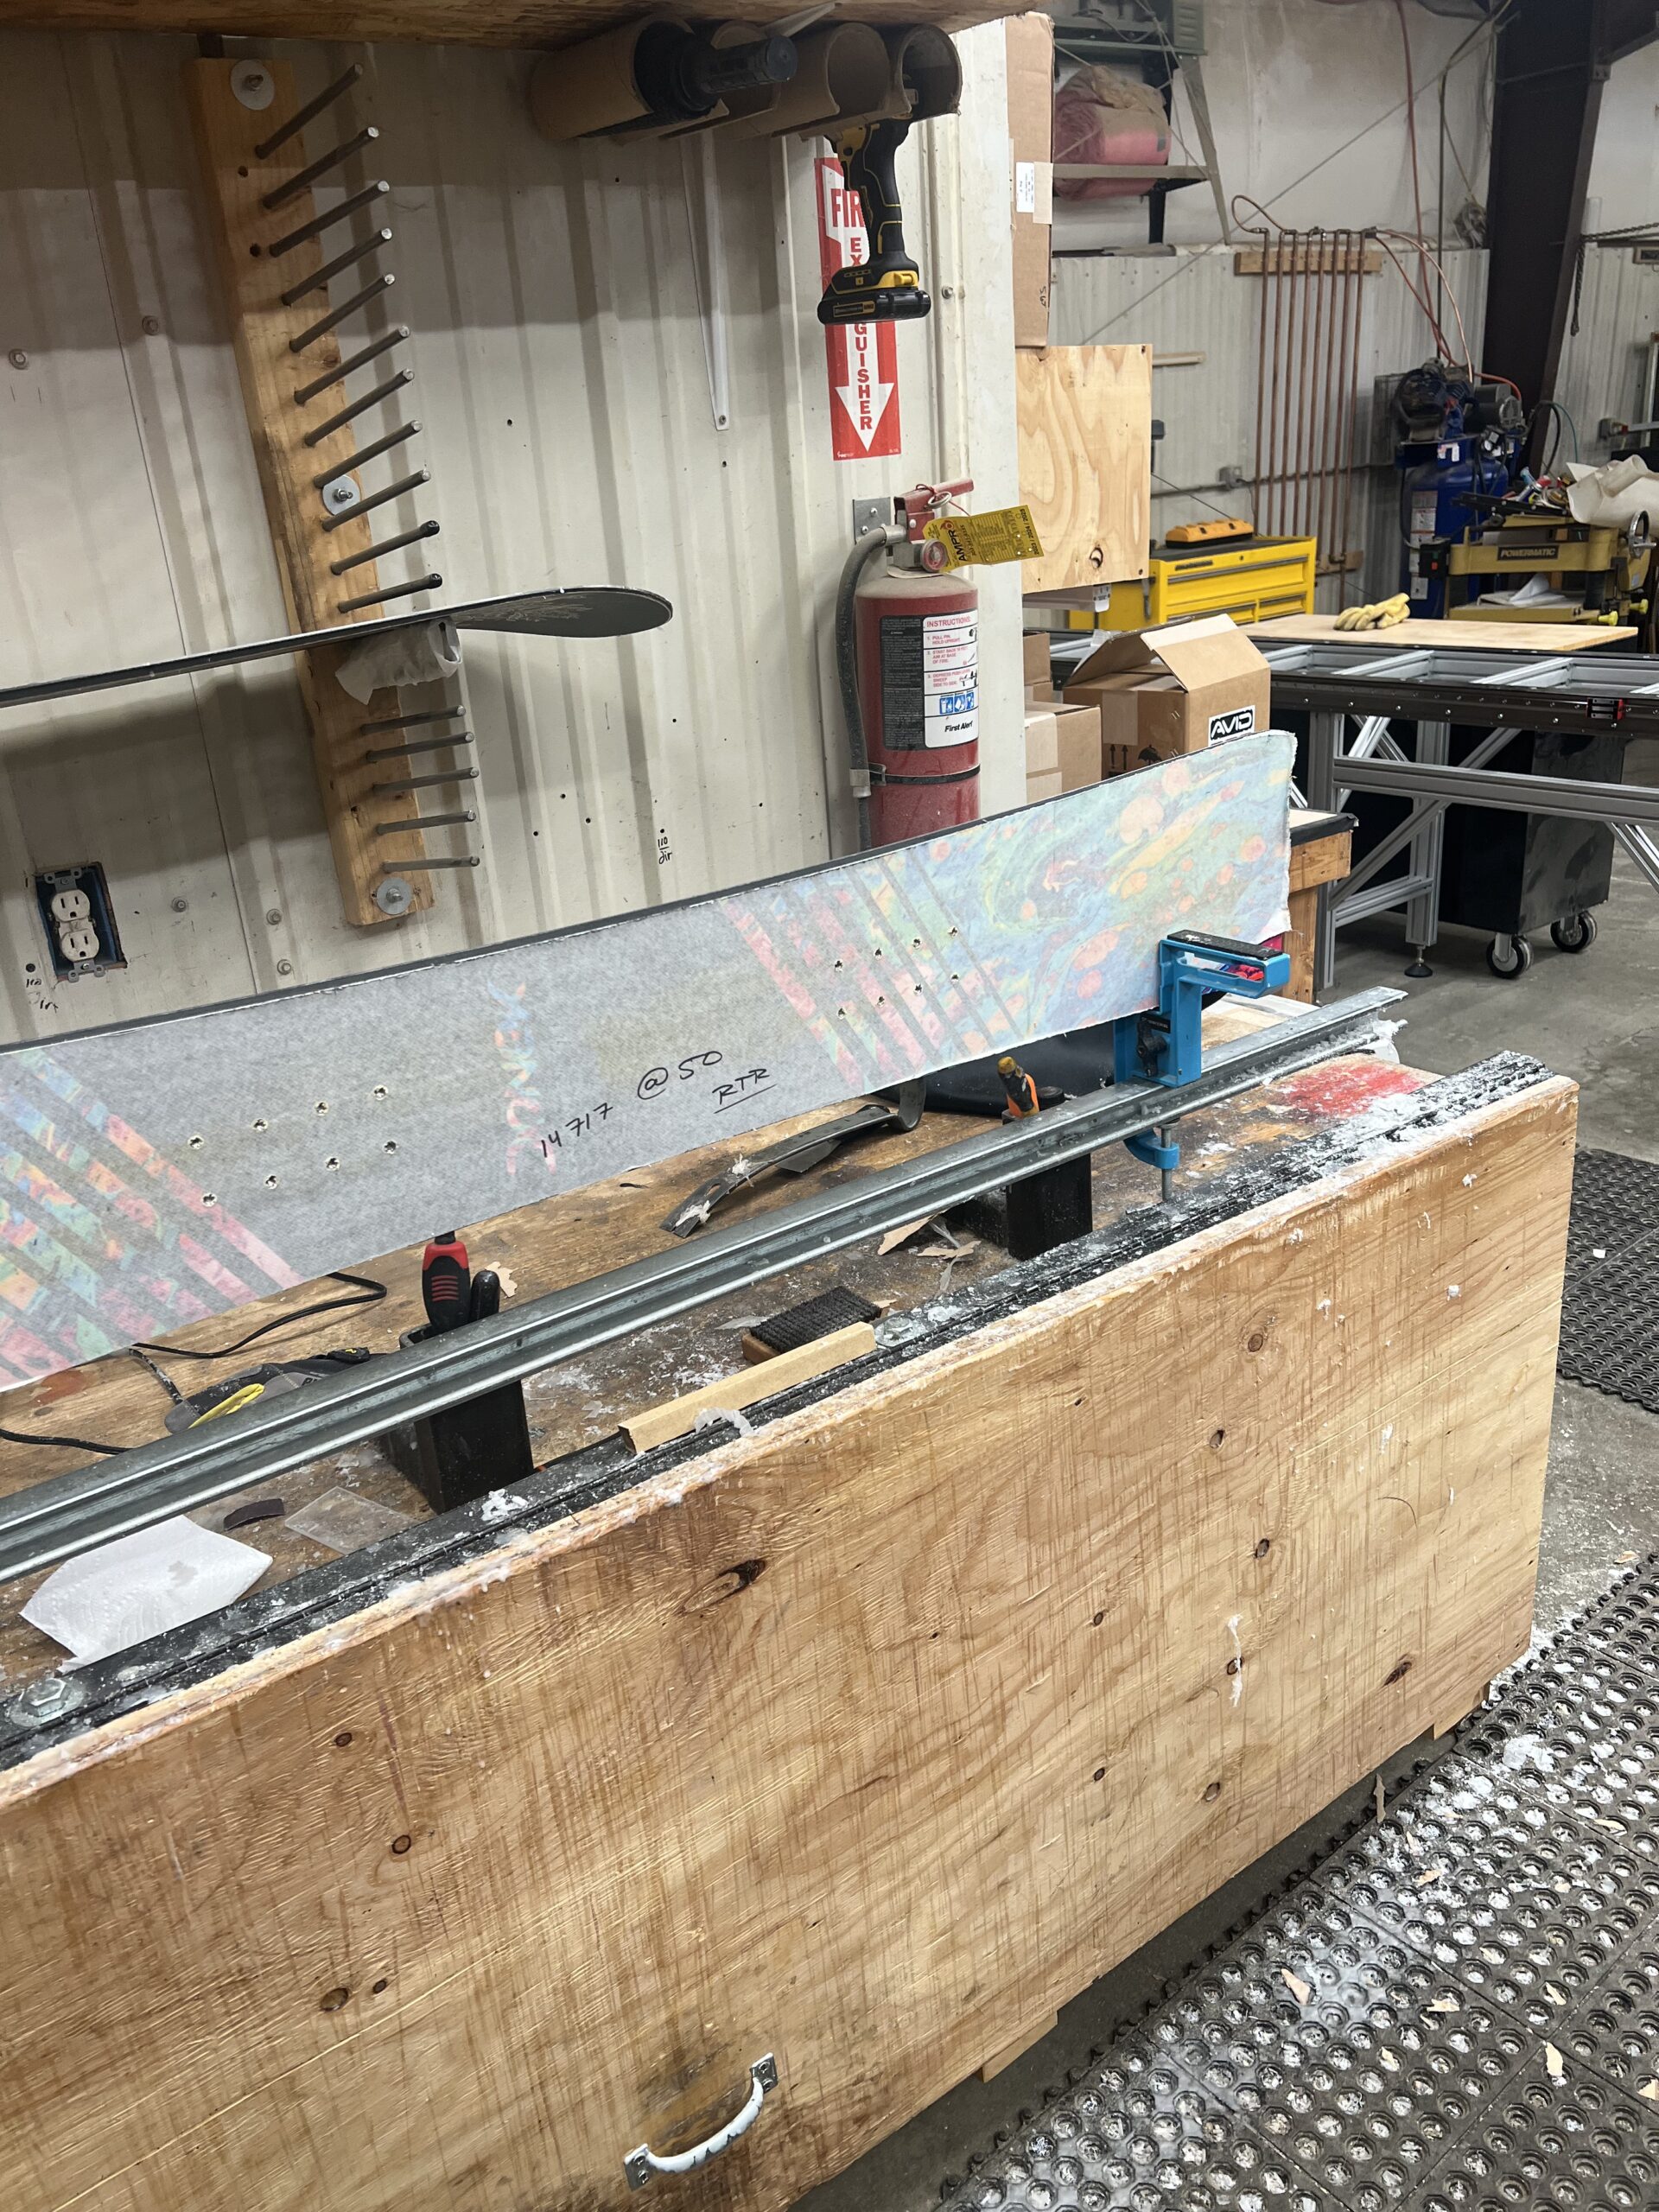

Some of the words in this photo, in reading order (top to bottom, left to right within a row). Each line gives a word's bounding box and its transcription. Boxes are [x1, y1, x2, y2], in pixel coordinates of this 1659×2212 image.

[830, 188, 865, 228] FIR
[850, 237, 873, 430] EXGUISHER
[1500, 548, 1555, 557] POWERMATIC
[944, 724, 960, 733] First
[961, 721, 973, 730] Alert
[1211, 711, 1253, 739] AVID
[658, 836, 668, 848] 110
